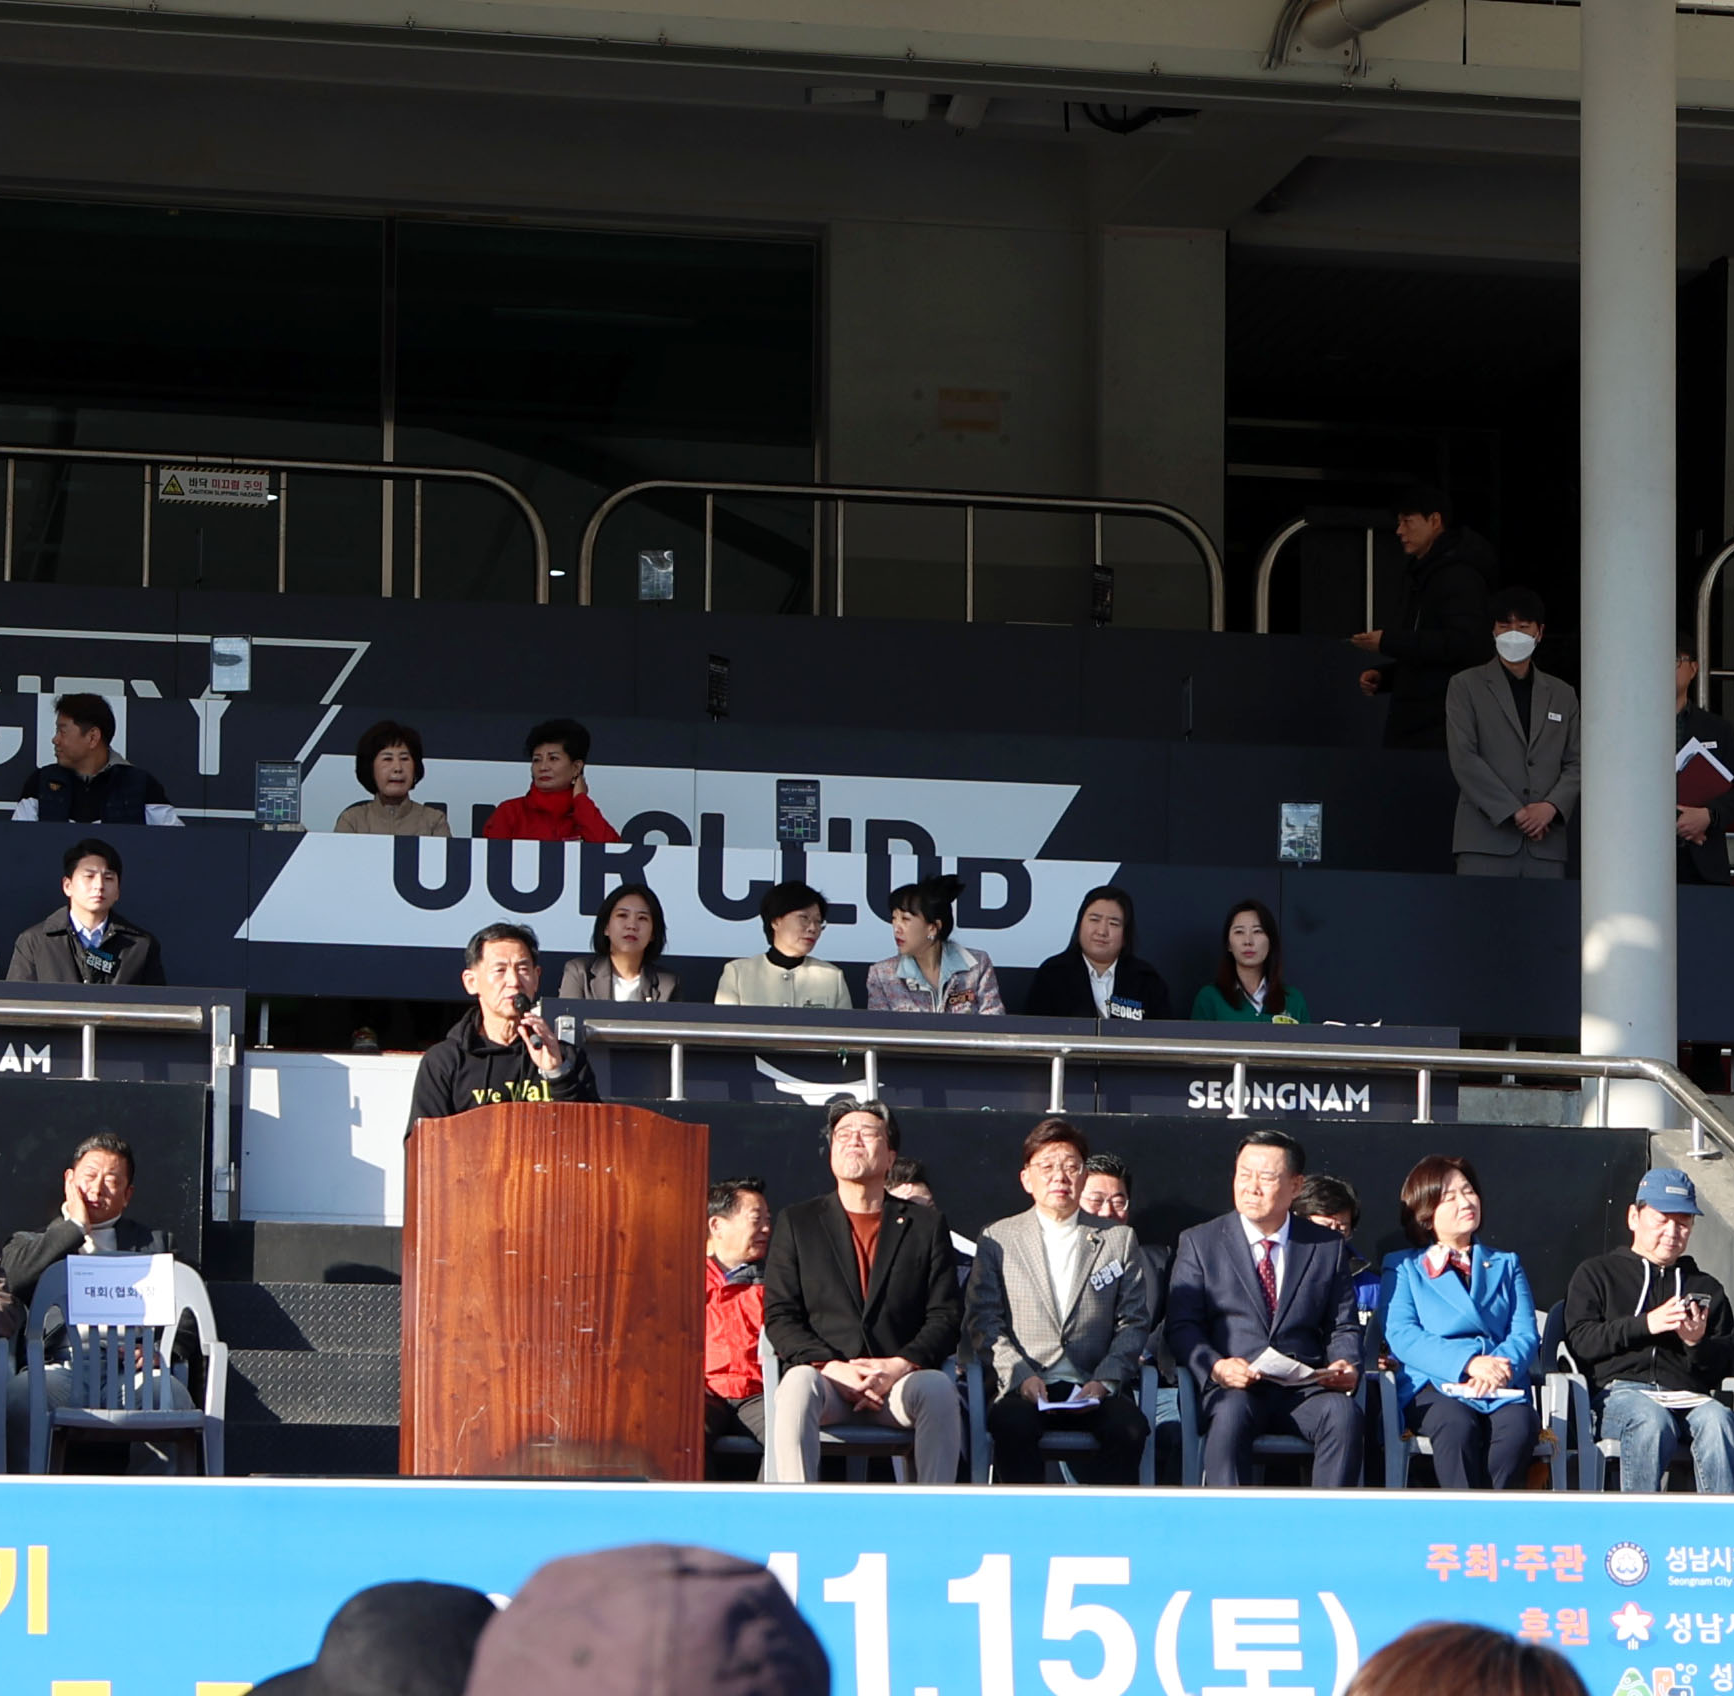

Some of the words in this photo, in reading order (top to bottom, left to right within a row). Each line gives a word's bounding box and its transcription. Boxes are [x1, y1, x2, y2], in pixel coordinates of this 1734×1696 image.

[188, 477, 208, 489] 바닥
[243, 480, 263, 491] 주의
[471, 1088, 502, 1105] We
[504, 1079, 552, 1102] Wal
[1187, 1080, 1370, 1112] SEONGNAM
[1425, 1543, 1588, 1583] 주최·주관
[1668, 1575, 1713, 1588] Seongnam
[1714, 1575, 1733, 1588] City
[1517, 1607, 1591, 1646] 후원
